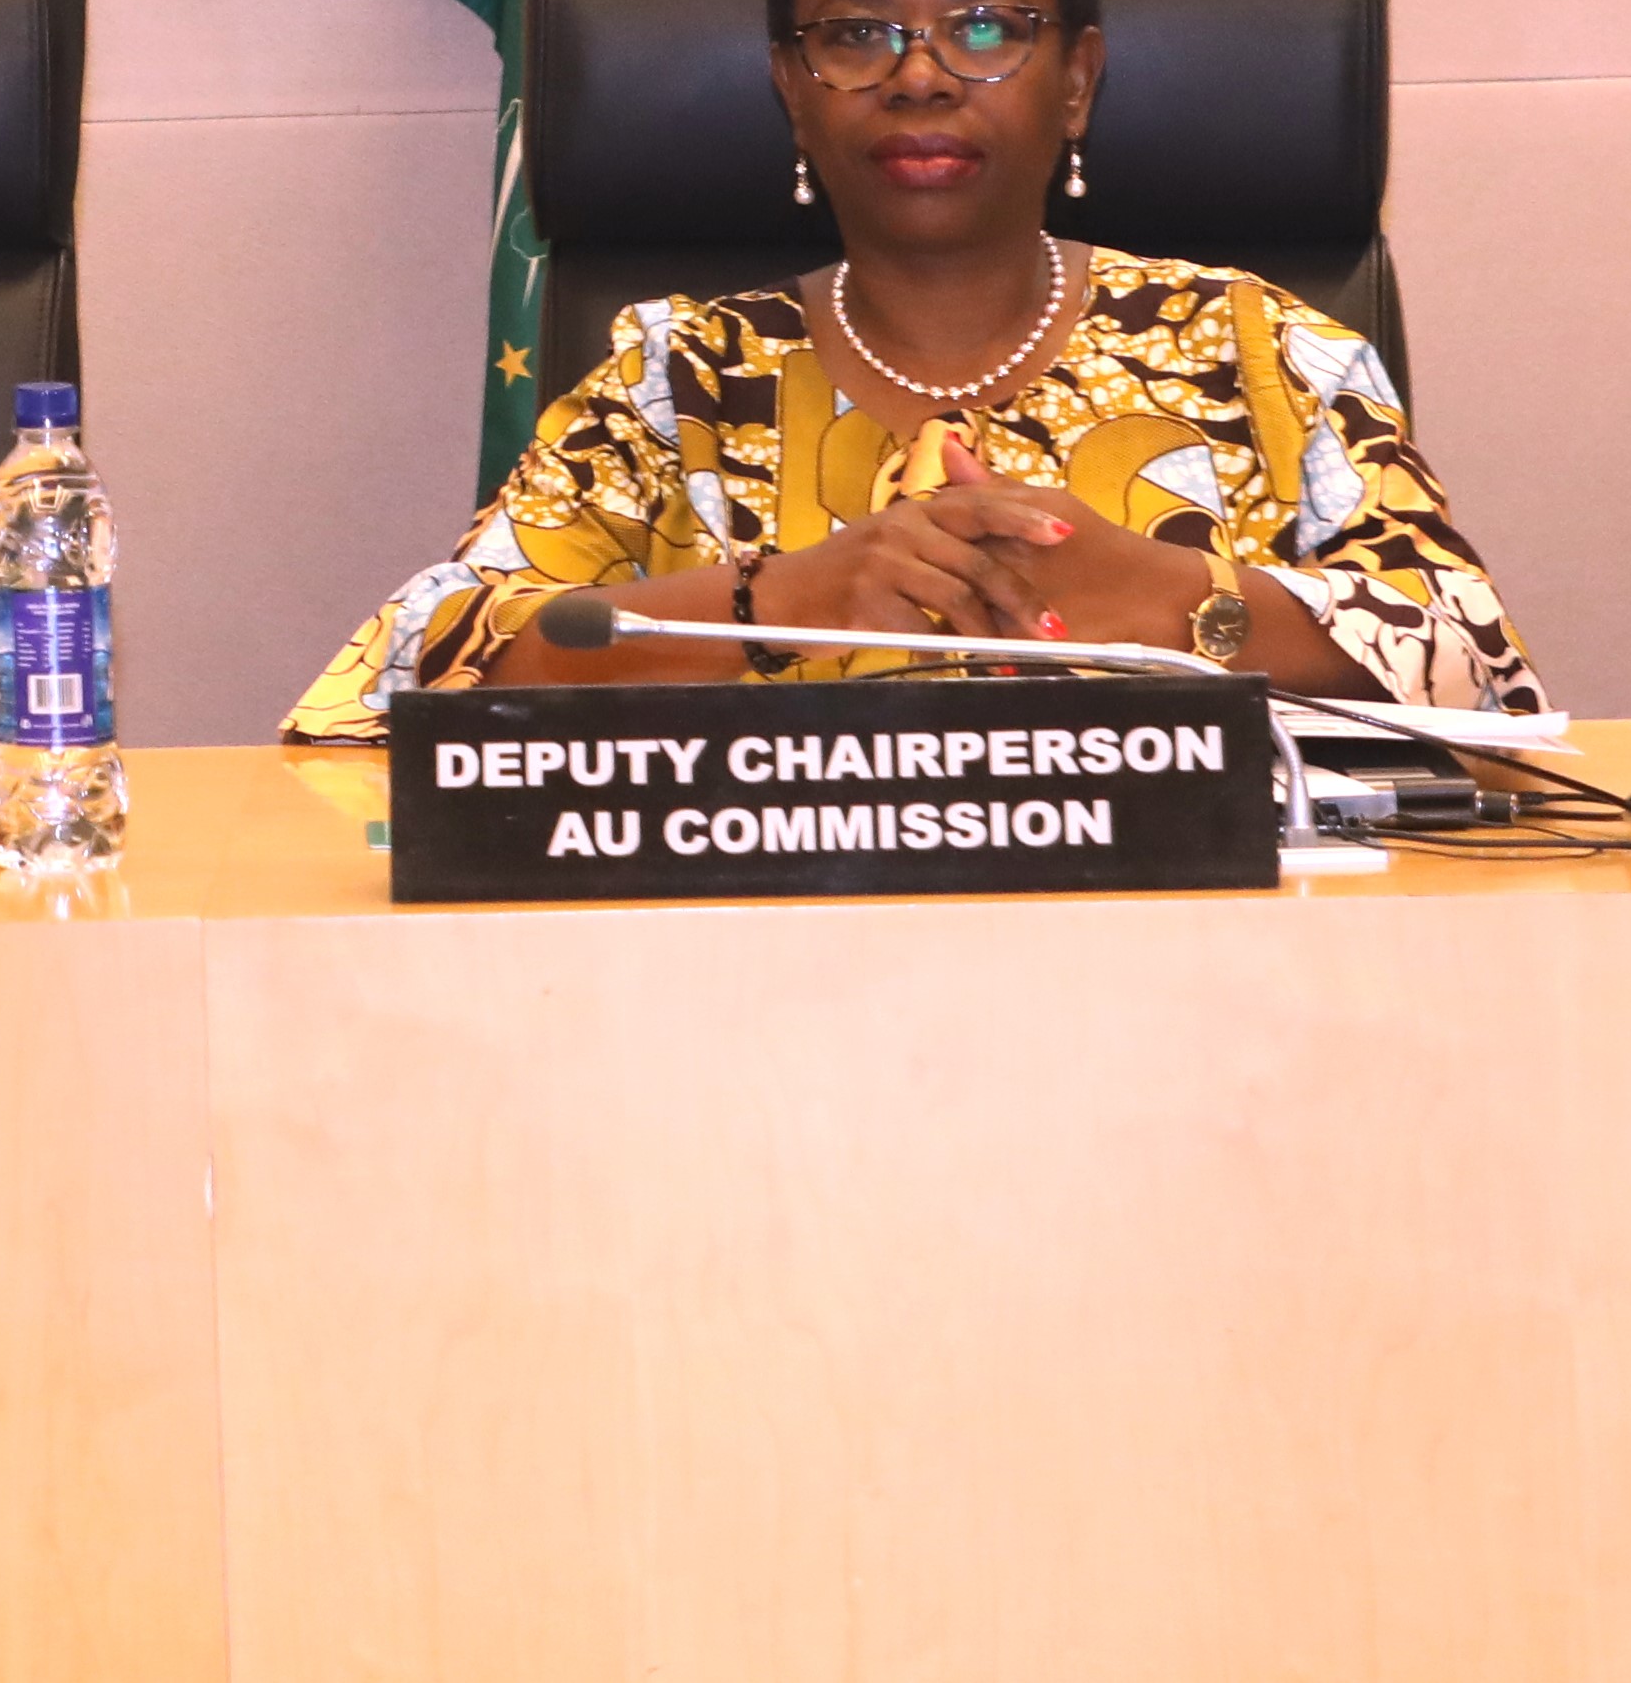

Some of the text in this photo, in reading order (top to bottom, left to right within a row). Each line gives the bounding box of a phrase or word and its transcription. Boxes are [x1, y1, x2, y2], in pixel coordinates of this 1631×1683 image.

[436, 726, 1223, 788] DEPUTY CHAIRPERSON
[547, 800, 1112, 857] AU COMMISSION
